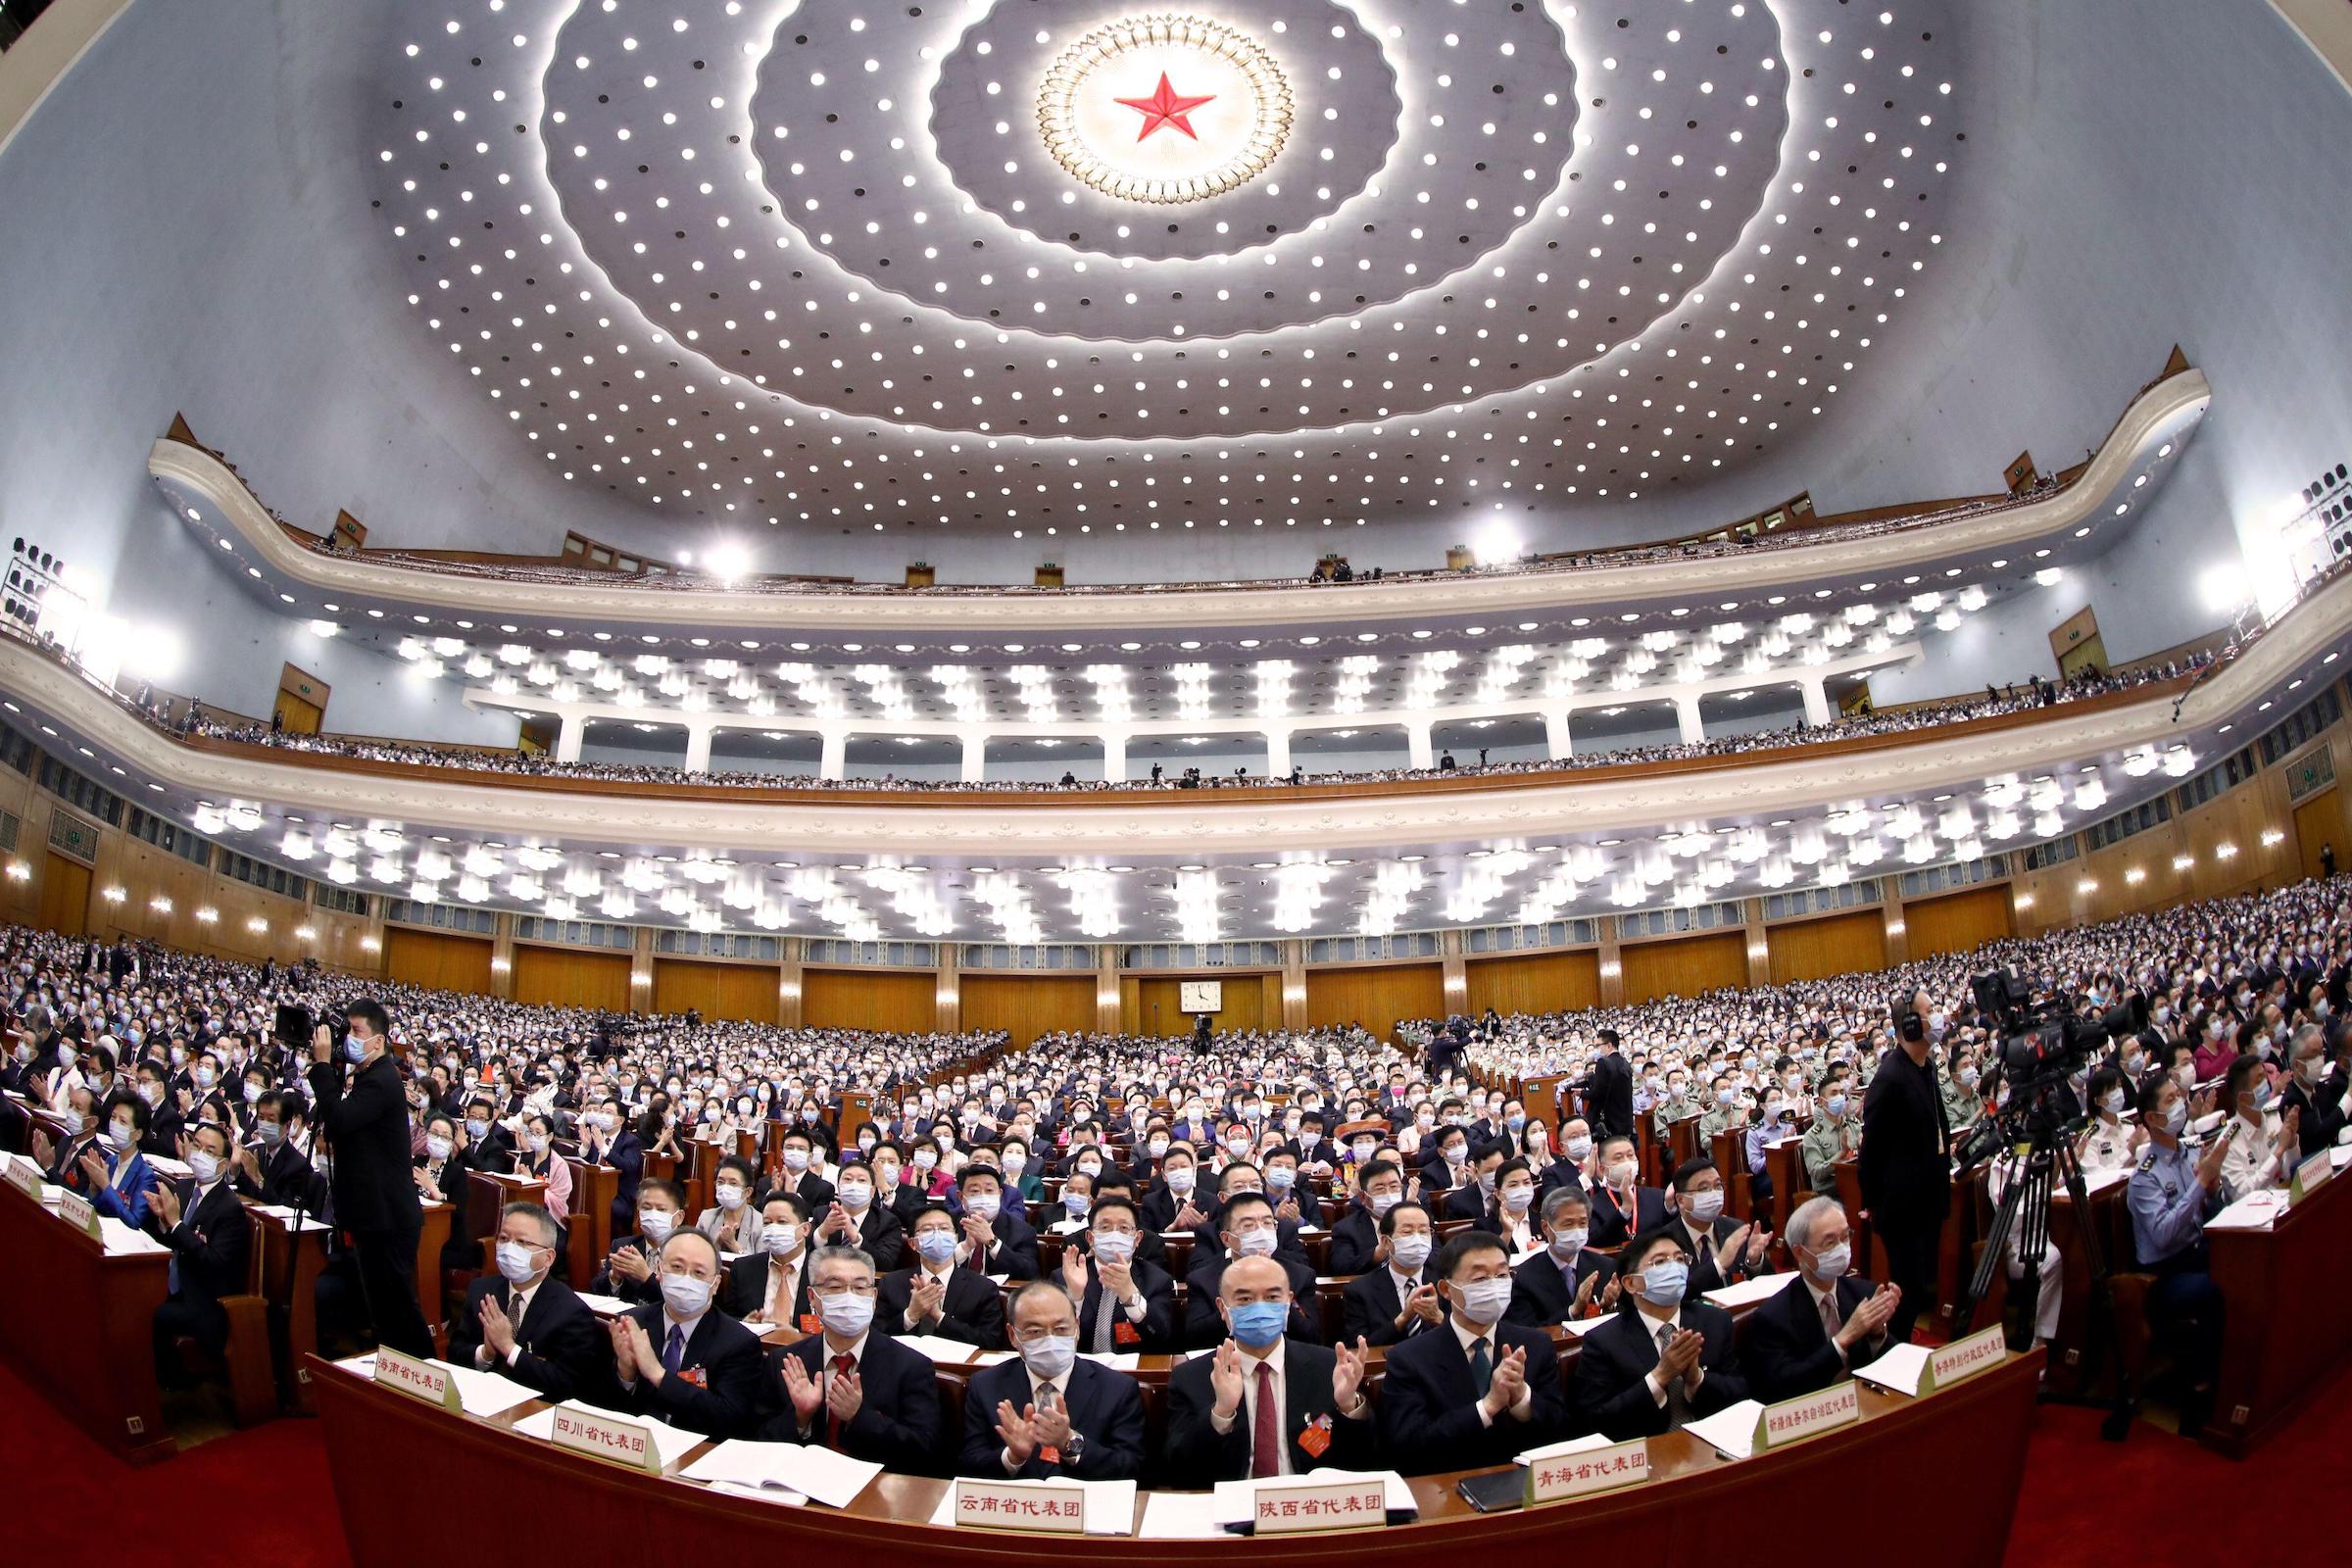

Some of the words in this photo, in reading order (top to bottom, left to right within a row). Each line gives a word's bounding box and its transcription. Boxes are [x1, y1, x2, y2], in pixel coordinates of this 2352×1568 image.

[378, 1357, 445, 1393] 海南省代表团
[1769, 1394, 1856, 1434] 新疆维吾尔自治区代表团
[558, 1418, 644, 1453] 四川省代表团
[1538, 1453, 1645, 1488] 青海省代表团
[960, 1494, 1081, 1518] 云南省代表团
[1258, 1494, 1382, 1518] 陕西省代表团
